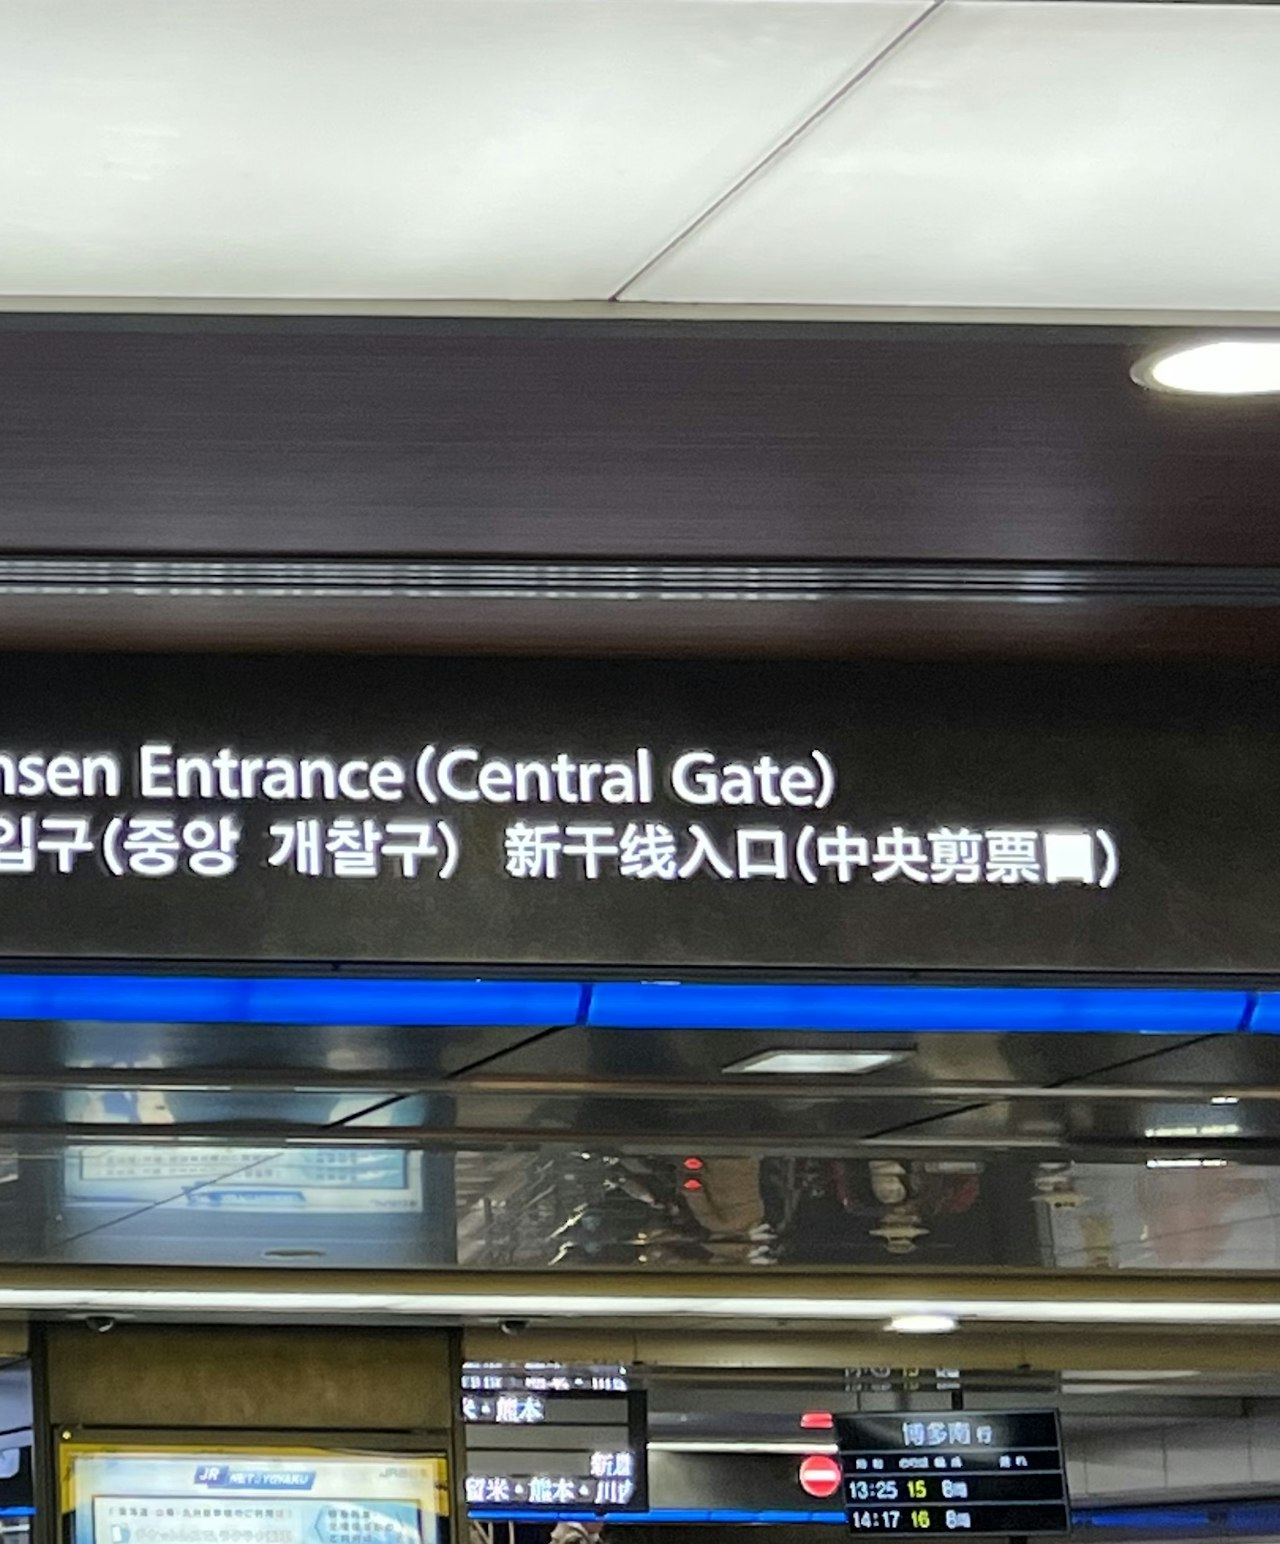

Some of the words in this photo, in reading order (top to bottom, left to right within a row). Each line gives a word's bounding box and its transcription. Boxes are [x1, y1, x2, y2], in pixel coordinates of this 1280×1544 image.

[141, 744, 404, 799] Entrance
[416, 747, 650, 803] (Central
[672, 750, 833, 808] Gate)
[269, 819, 458, 880] 개찰구)
[849, 1480, 899, 1500] 13:25
[907, 1479, 927, 1498] 15
[852, 1510, 901, 1529] 14:17
